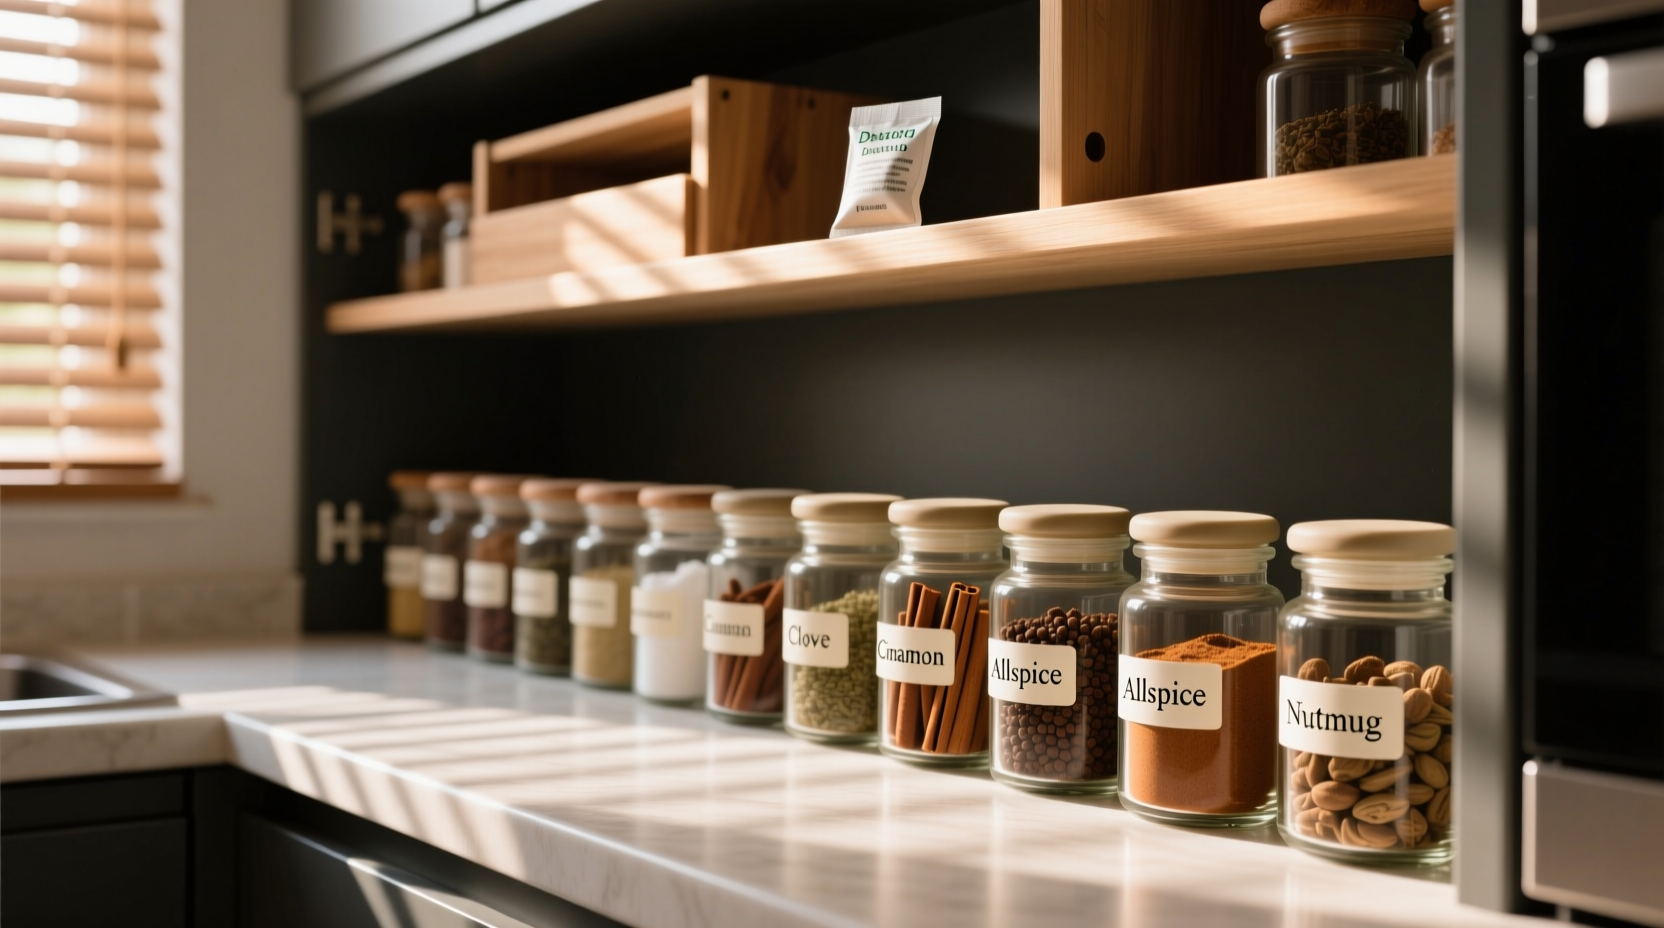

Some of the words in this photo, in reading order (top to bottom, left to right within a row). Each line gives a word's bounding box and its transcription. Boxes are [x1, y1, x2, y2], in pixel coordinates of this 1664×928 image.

[788, 625, 831, 648] Clove
[991, 658, 1062, 689] Allspice
[1123, 677, 1206, 711] Allspice
[1287, 699, 1382, 742] Nutmug
